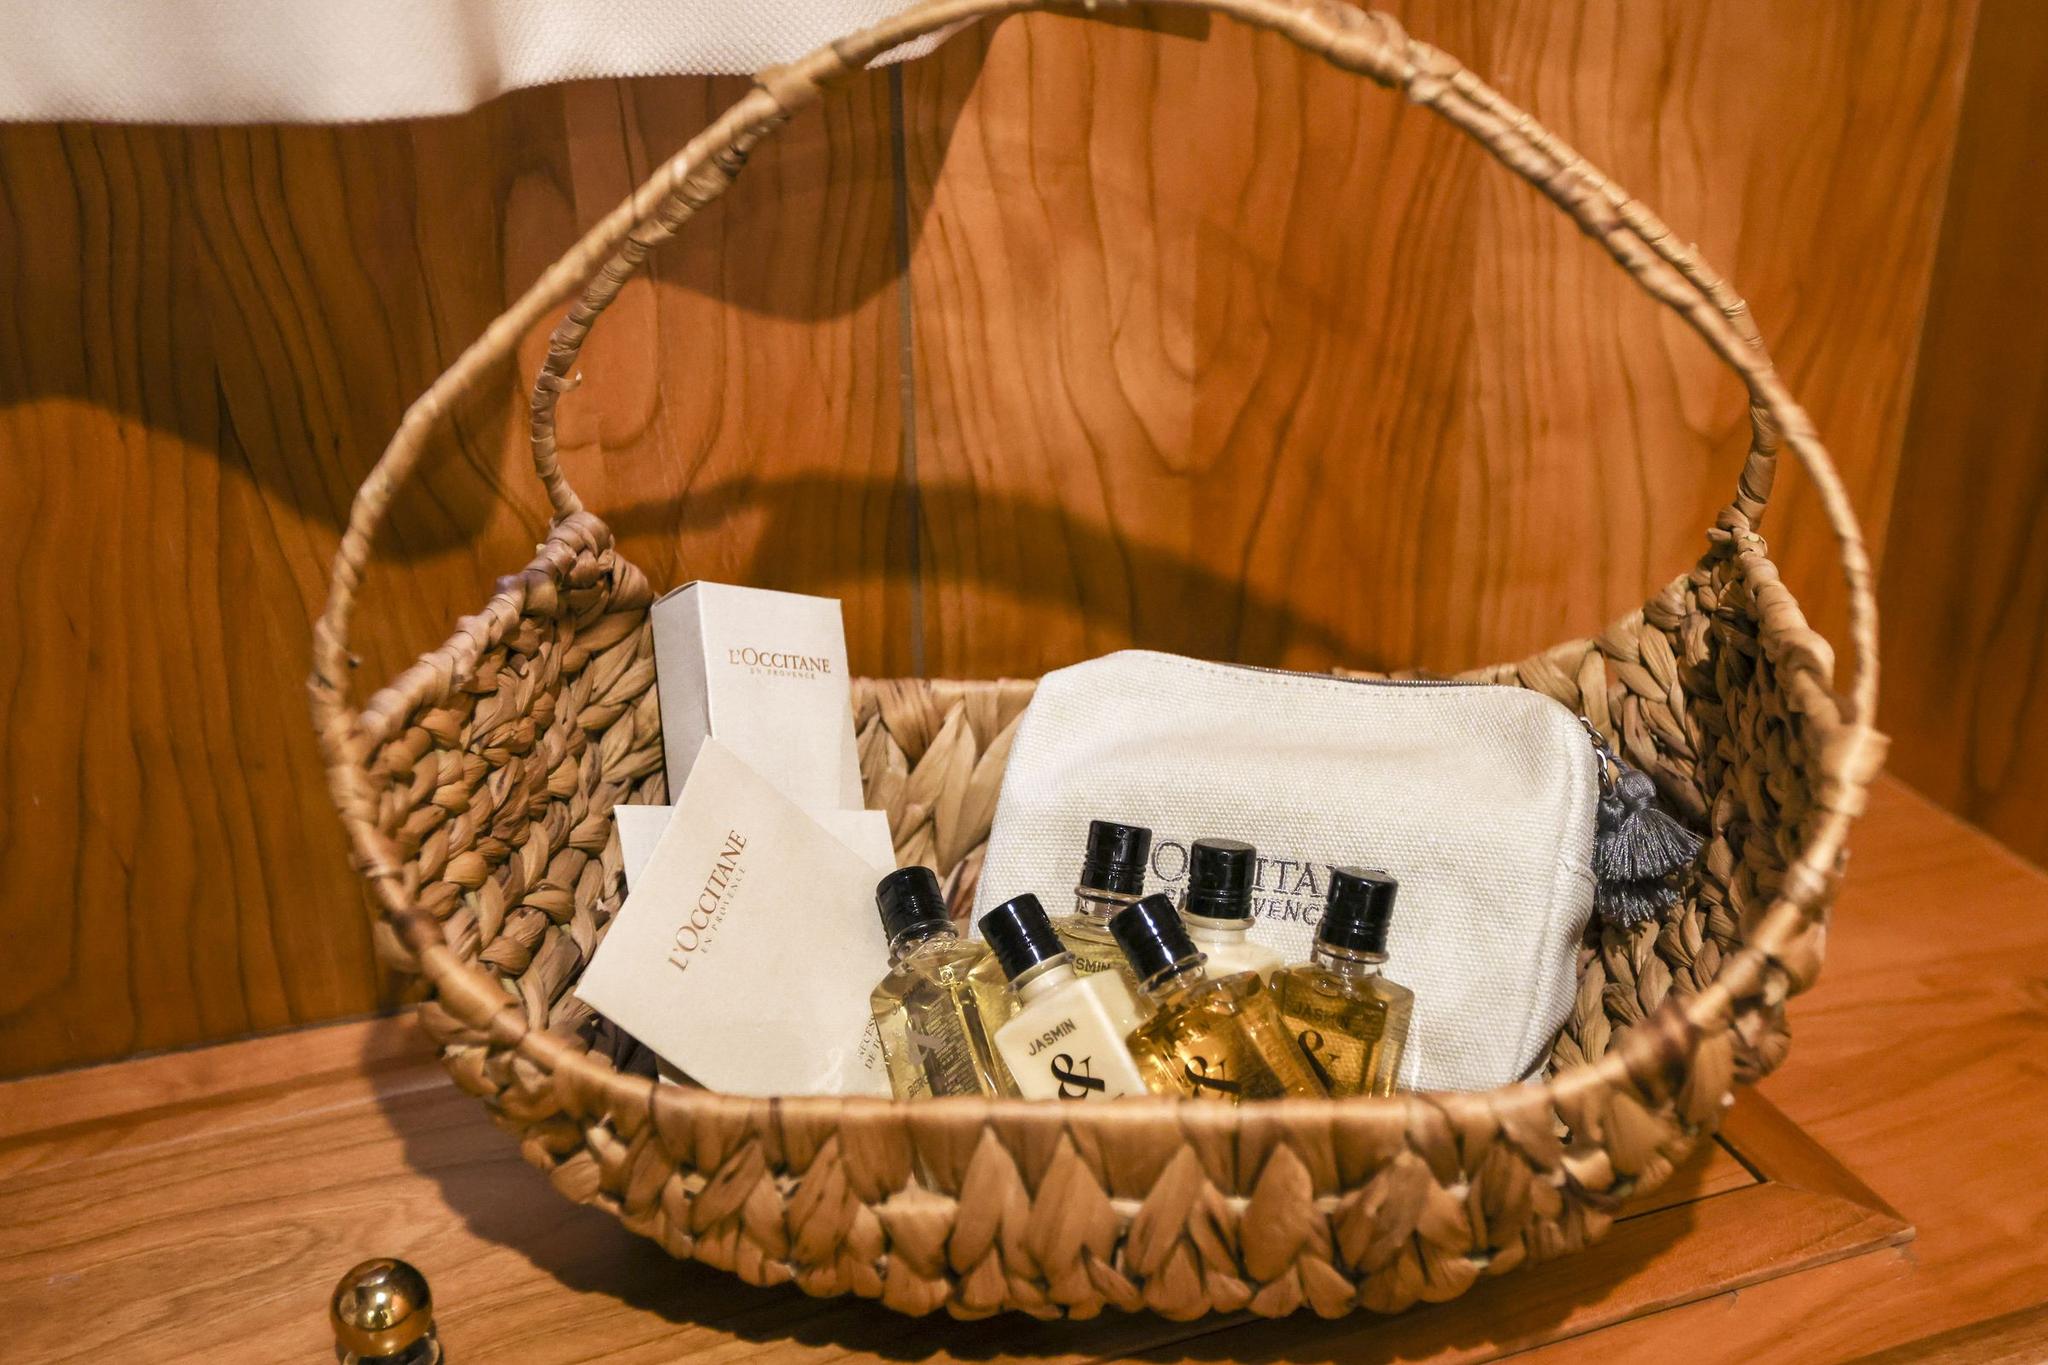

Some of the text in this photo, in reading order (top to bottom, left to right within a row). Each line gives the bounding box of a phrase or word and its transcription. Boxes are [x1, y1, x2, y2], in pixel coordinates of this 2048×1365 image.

[729, 647, 831, 673] L'OCCITANE
[668, 829, 748, 971] L'OCCITANE
[1075, 957, 1110, 973] SMIN
[1028, 1018, 1077, 1056] JASMIN
[1051, 1053, 1105, 1099] &
